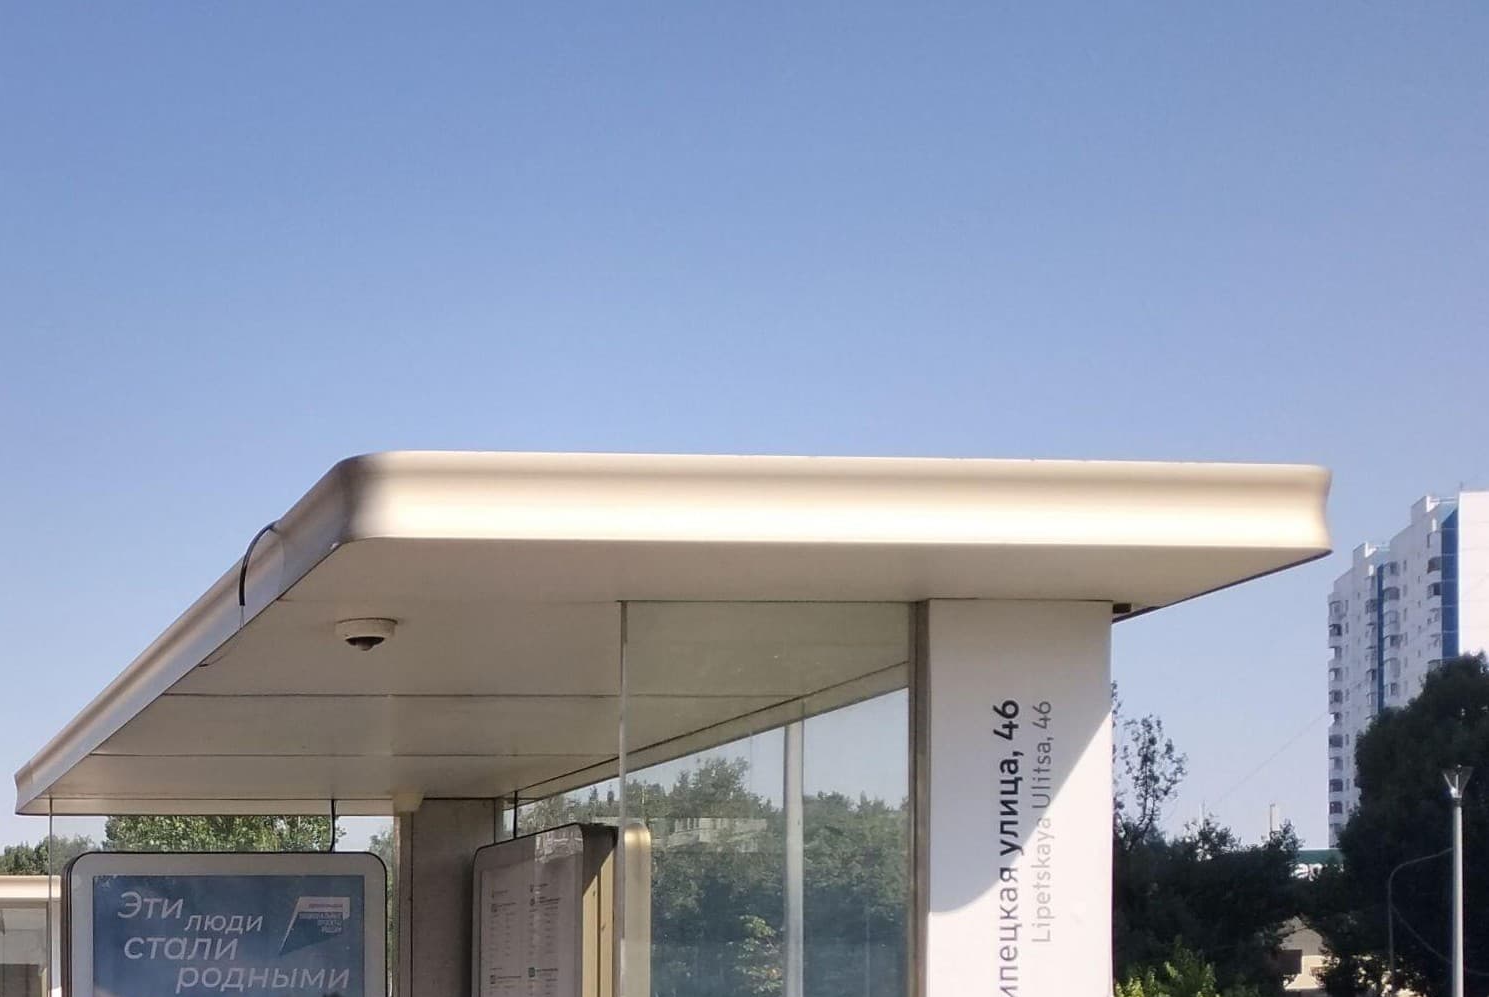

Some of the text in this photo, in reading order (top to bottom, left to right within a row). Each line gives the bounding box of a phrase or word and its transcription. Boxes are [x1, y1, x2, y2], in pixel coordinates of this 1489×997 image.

[992, 699, 1019, 741] 46
[999, 748, 1024, 856] улица,
[1031, 700, 1056, 942] Lipetskaya Ulitsa, 46
[117, 891, 184, 919] Эти
[184, 914, 263, 935] люди
[124, 937, 239, 960] стали
[175, 967, 350, 994] родными
